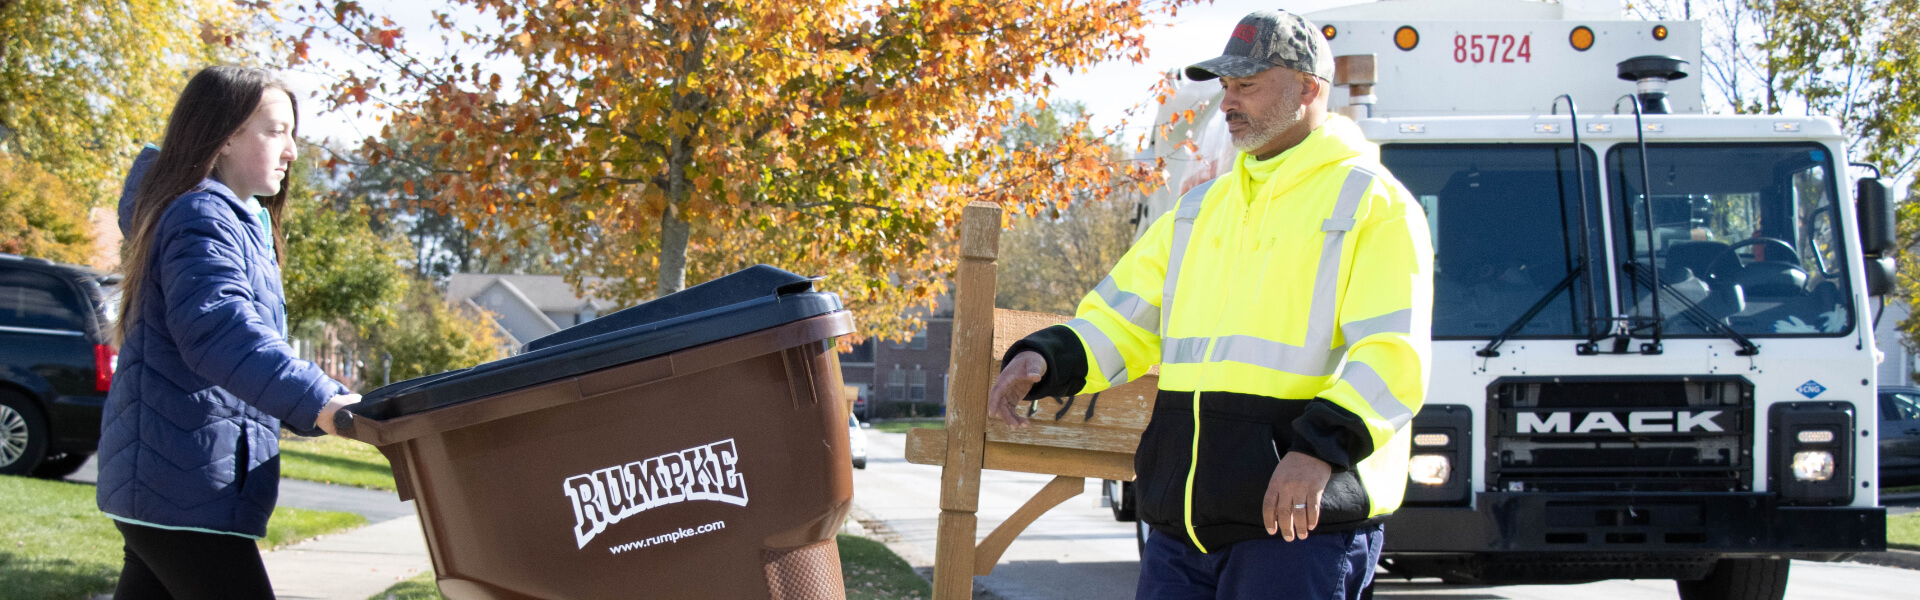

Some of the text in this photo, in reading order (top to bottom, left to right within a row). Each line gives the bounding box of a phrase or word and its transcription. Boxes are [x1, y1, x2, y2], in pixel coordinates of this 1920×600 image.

[1453, 34, 1531, 63] 85724
[1516, 411, 1725, 433] MACK
[563, 438, 748, 549] RUMPKE
[609, 520, 725, 554] www.rumpke.com
